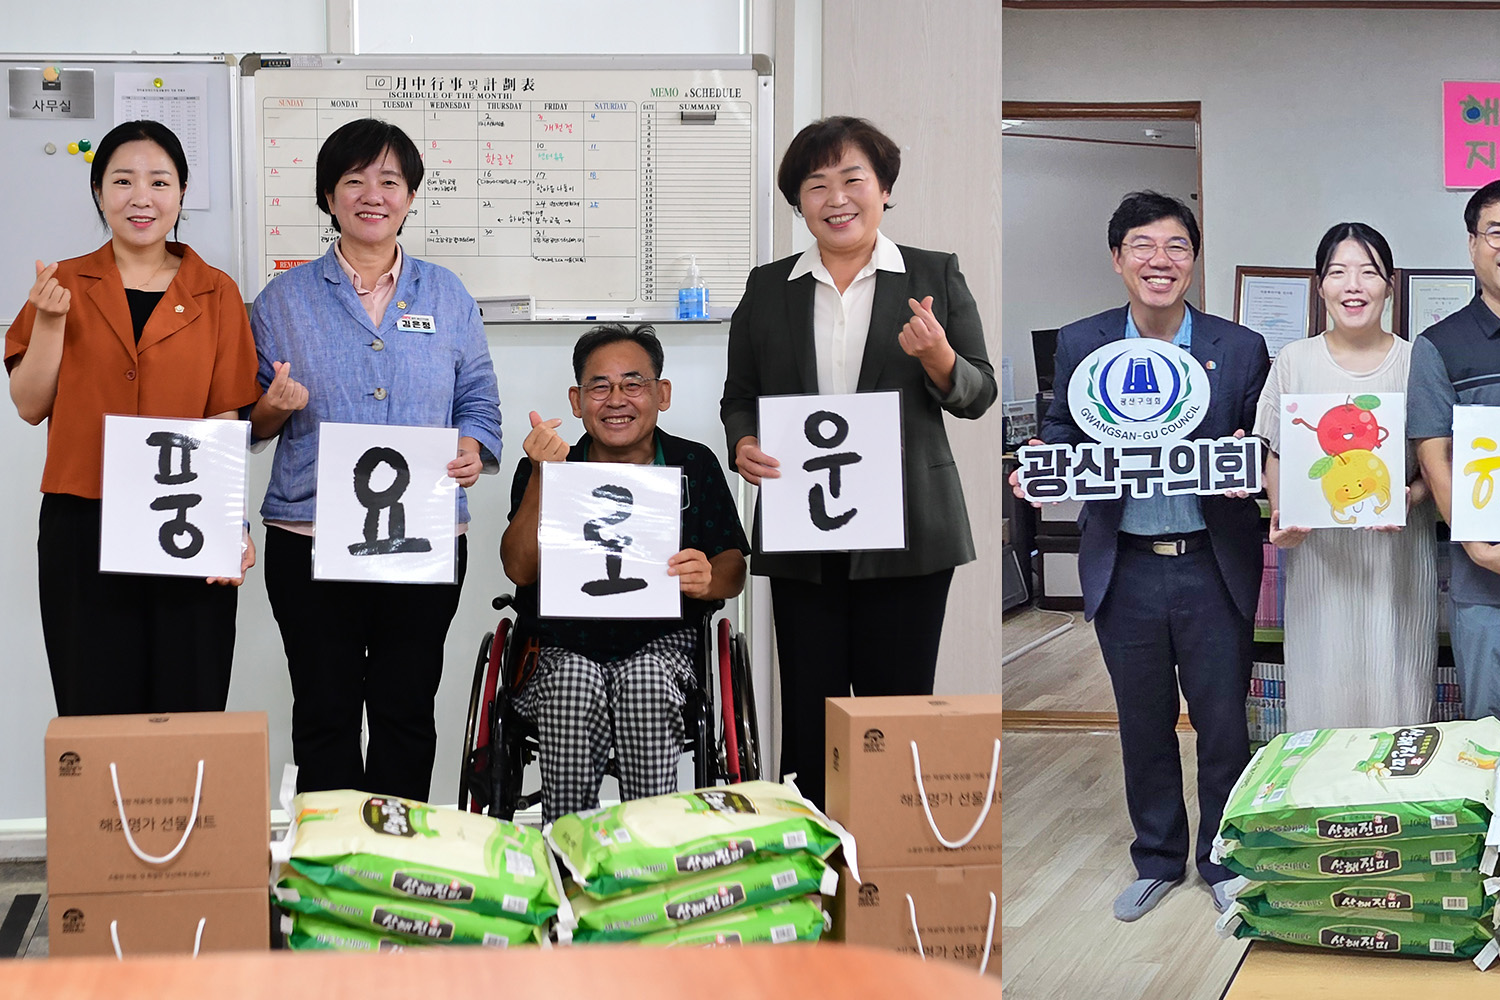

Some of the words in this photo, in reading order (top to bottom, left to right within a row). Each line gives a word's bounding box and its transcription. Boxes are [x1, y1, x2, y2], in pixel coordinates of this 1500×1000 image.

[373, 77, 386, 88] 10
[650, 87, 679, 98] MEMO
[690, 87, 741, 98] SCHEDULE
[32, 99, 72, 113] 사무실
[279, 99, 305, 107] SUNDAY
[330, 100, 359, 108] MONDAY
[382, 101, 414, 109] TUESDAY
[430, 102, 471, 110] WEDNESDAY
[487, 102, 522, 110] THURSDAY
[544, 103, 569, 111] FRIDAY
[594, 102, 628, 111] SATURDAY
[544, 123, 574, 134] 개천절
[432, 141, 437, 149] 8
[486, 142, 491, 150] 9
[485, 153, 514, 166] 한글날
[483, 169, 492, 177] 16
[270, 226, 280, 235] 26
[402, 319, 431, 330] 김은정
[1121, 397, 1161, 406] 광산구의회
[1081, 407, 1159, 441] GWANGSAN-GU
[1161, 405, 1200, 437] COUNCIL
[803, 410, 862, 531] 운
[1024, 442, 1256, 498] 광산구의회
[145, 431, 204, 559] 풍
[348, 446, 432, 555] 요
[580, 484, 648, 596] 로
[1328, 821, 1389, 839] 산해진미
[1330, 857, 1390, 874] 산해진미
[1341, 897, 1402, 910] 산해진미
[1331, 933, 1390, 951] 산해진미
